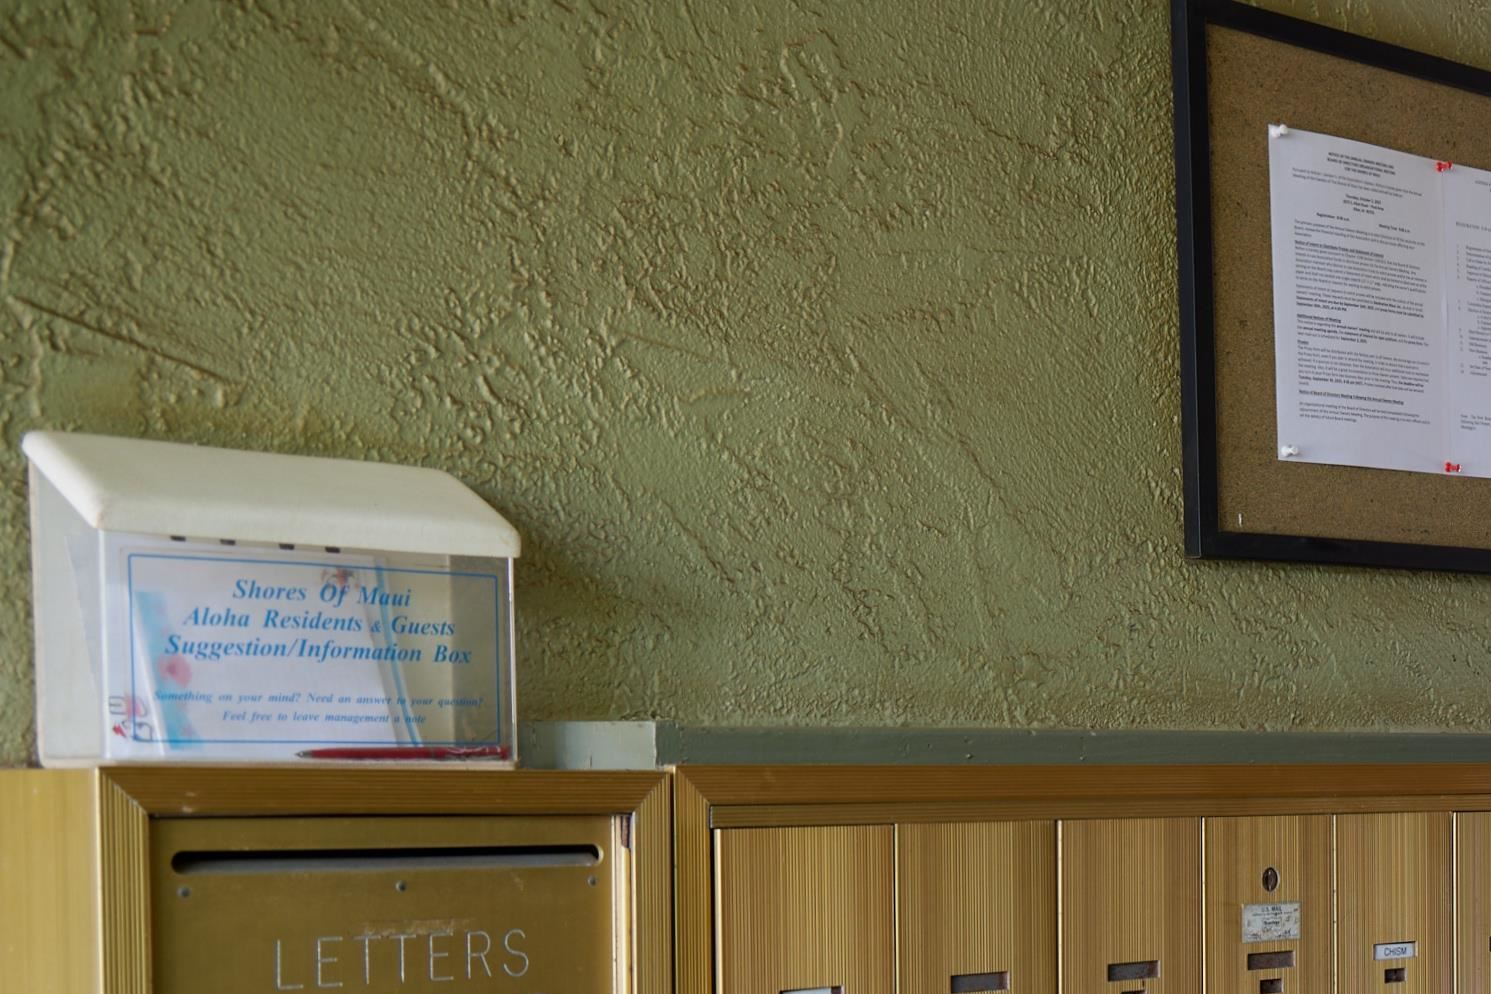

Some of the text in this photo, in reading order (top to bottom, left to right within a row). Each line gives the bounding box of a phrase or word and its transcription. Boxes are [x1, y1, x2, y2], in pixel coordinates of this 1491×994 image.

[233, 579, 411, 608] Shores Of Maui
[183, 607, 456, 636] Aloha Residents & Guests
[164, 634, 473, 664] Suggestion/Information Box
[218, 693, 233, 702] on
[237, 693, 263, 705] your
[268, 691, 302, 703] mind?
[308, 692, 334, 703] Need
[337, 696, 352, 704] an
[222, 710, 247, 722] Feel
[250, 710, 273, 723] free
[277, 711, 288, 721] to
[292, 711, 320, 722] leave
[325, 711, 390, 725] management
[274, 928, 530, 990] LETTERS
